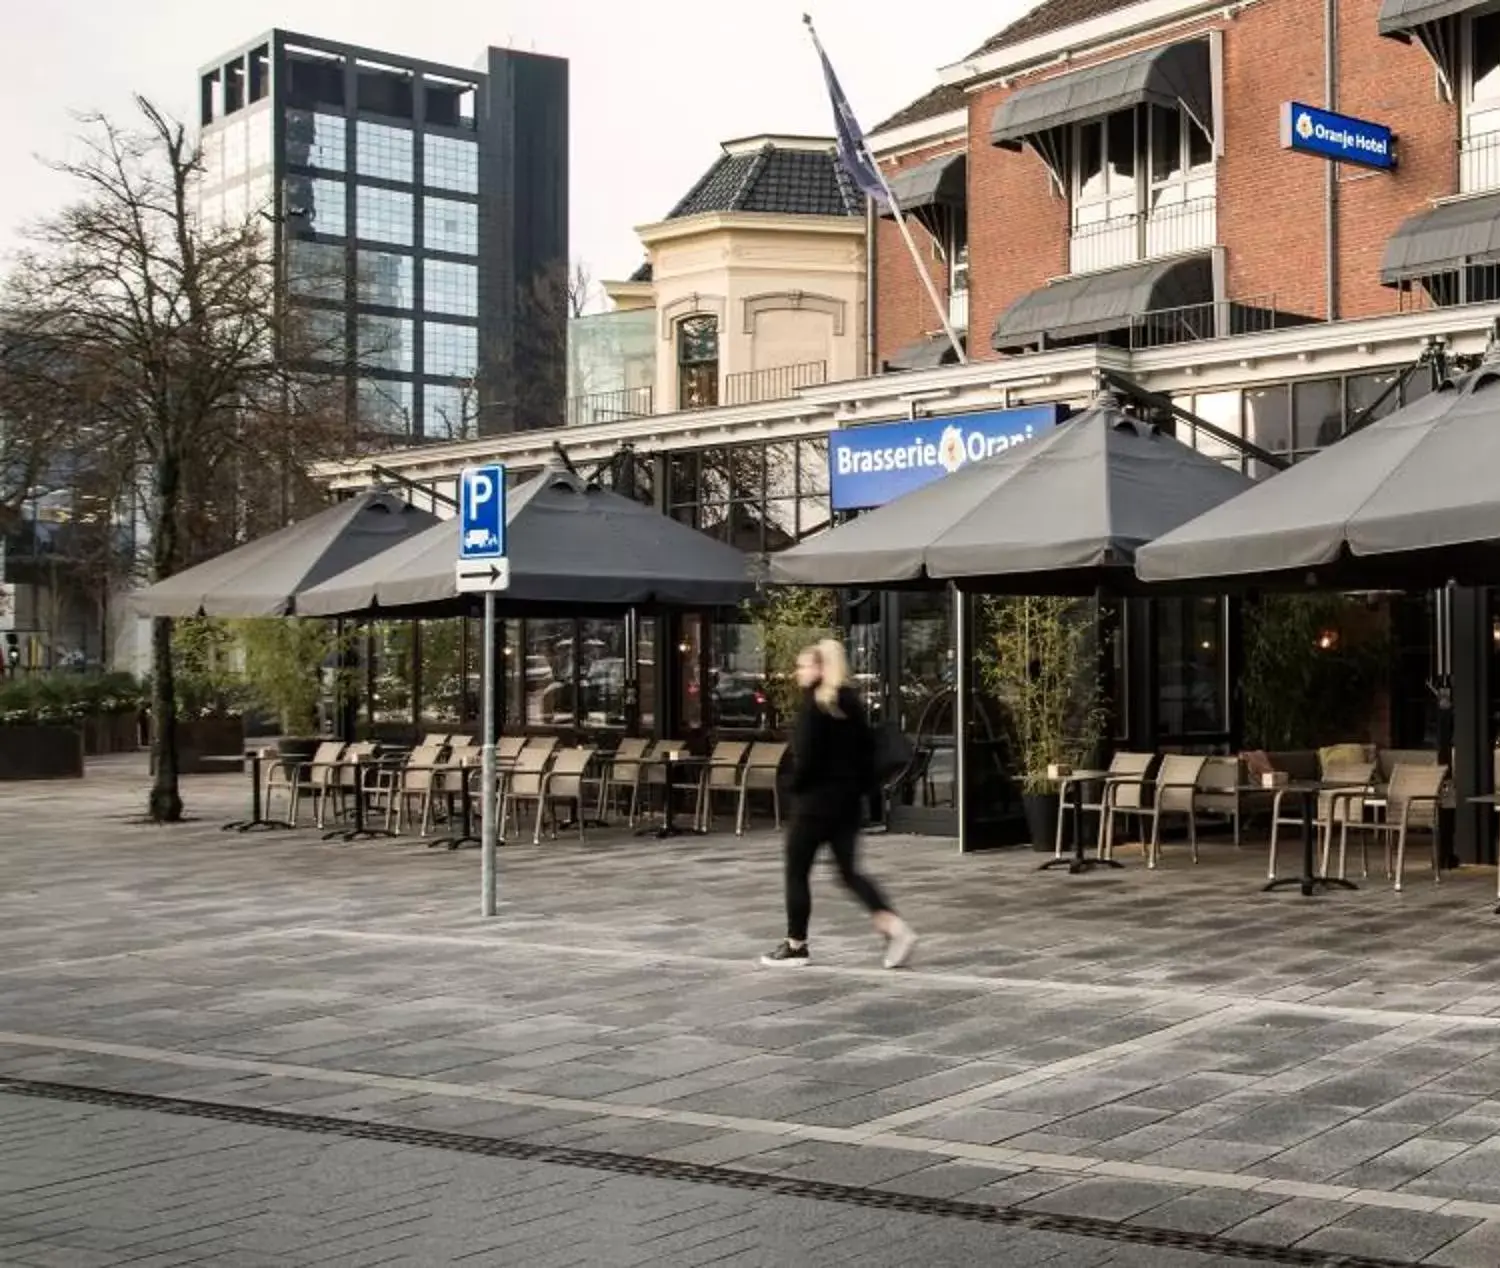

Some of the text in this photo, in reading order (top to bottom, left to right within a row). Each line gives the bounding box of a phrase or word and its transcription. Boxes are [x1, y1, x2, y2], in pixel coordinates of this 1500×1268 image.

[1315, 123, 1387, 154] Oranje Hotel
[837, 437, 937, 475] Brasserie
[469, 475, 493, 521] P
